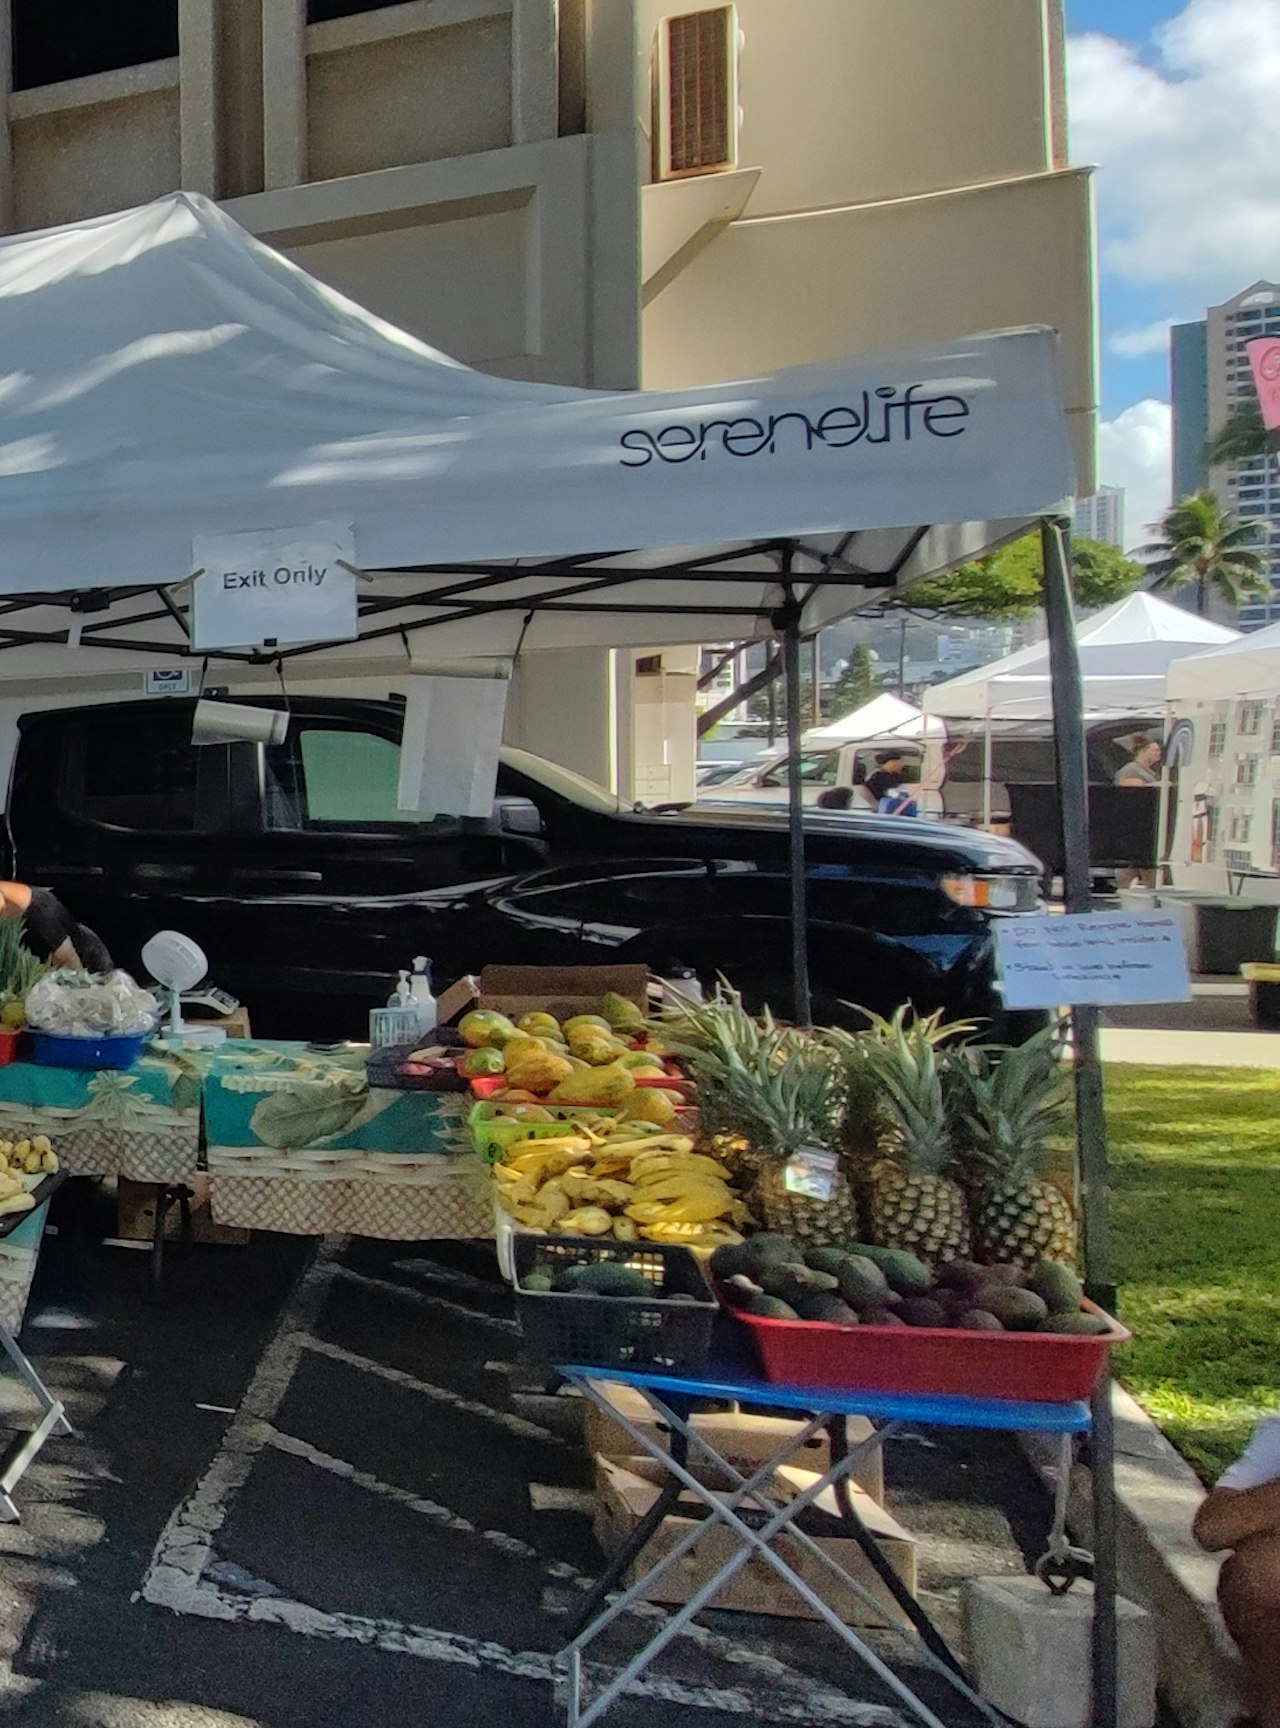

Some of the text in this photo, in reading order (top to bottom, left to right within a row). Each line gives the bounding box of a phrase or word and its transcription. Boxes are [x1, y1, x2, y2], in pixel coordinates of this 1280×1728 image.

[619, 384, 971, 468] serenelife
[223, 565, 328, 590] Exit Only
